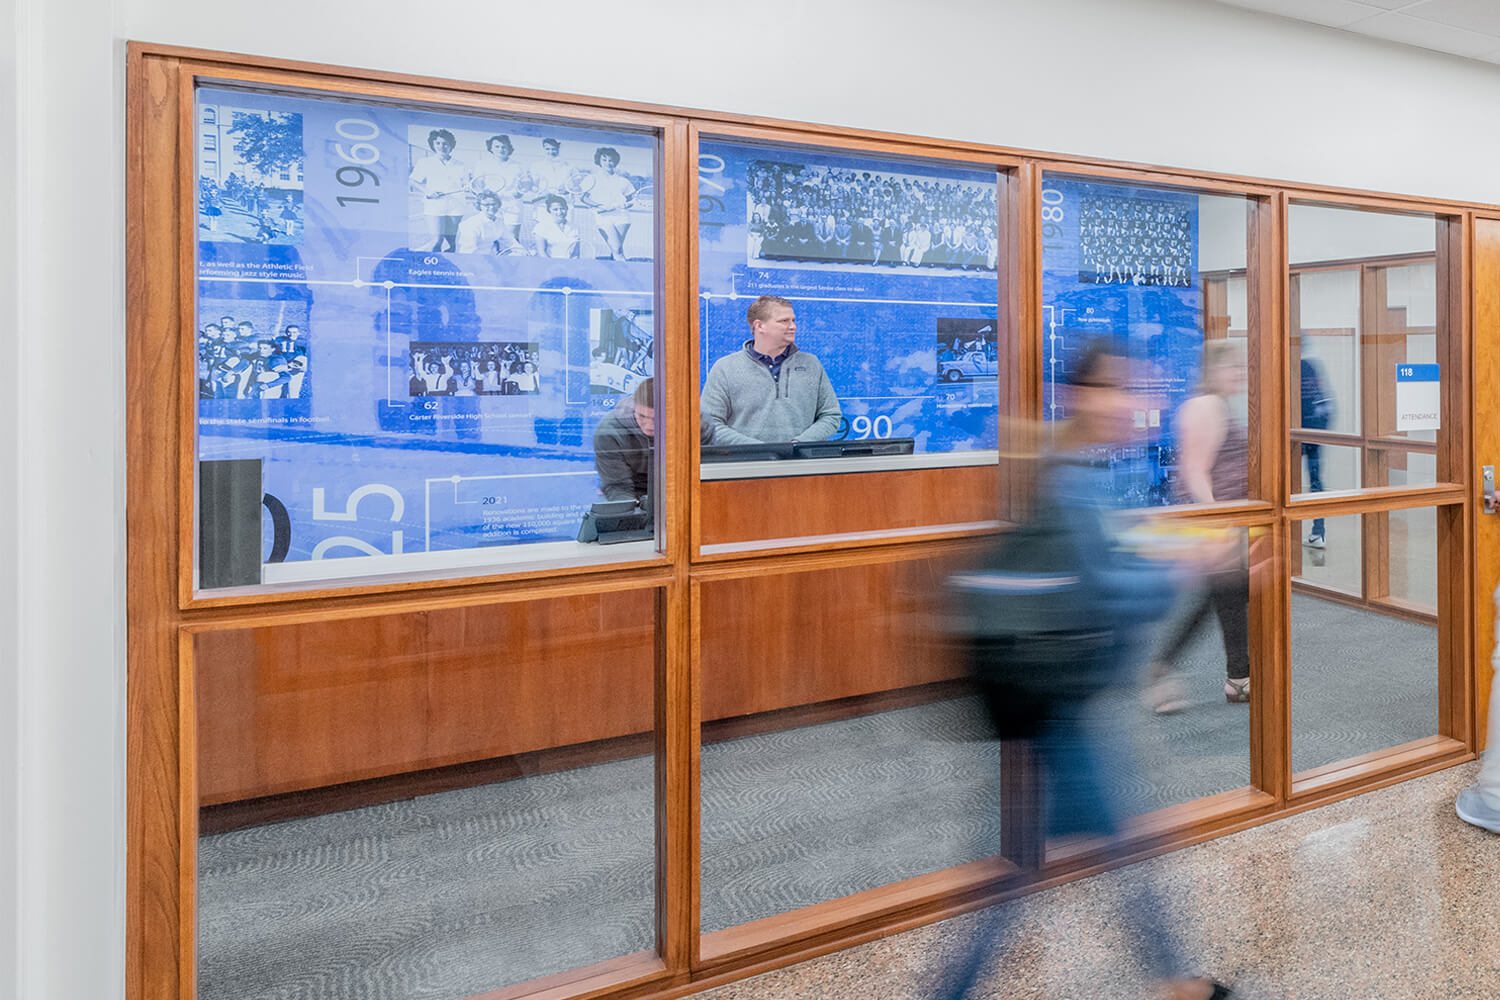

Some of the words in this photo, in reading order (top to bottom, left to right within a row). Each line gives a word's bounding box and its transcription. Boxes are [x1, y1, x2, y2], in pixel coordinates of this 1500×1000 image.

[335, 118, 380, 207] 1960
[261, 263, 293, 271] Athletic
[258, 270, 278, 279] style
[1400, 367, 1413, 377] 118
[1401, 412, 1438, 421] ATTENDANCE
